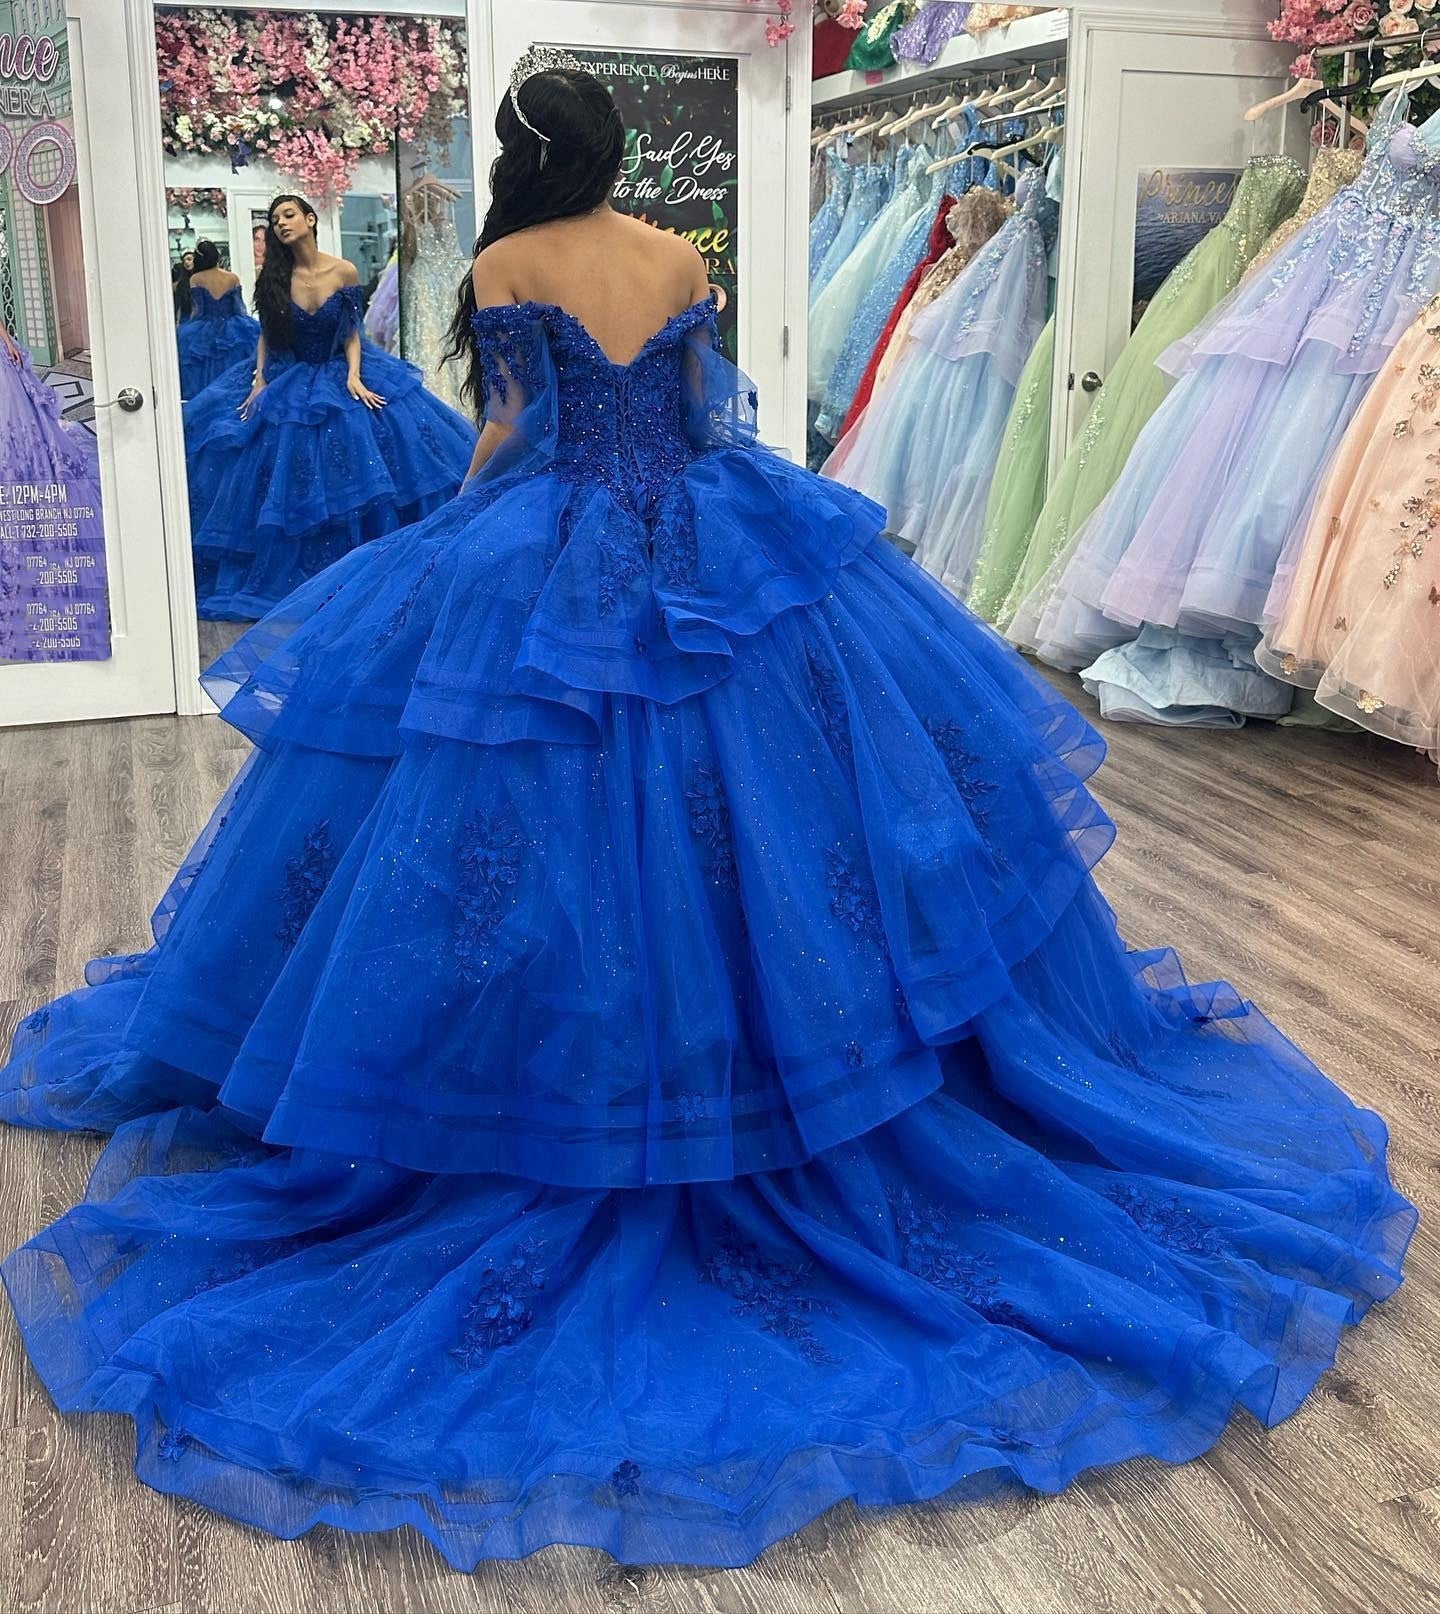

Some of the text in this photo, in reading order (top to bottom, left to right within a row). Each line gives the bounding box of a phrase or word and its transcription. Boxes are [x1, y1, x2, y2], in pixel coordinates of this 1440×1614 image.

[661, 64, 698, 84] Begins
[698, 68, 730, 81] HERE
[620, 131, 736, 176] Said Yes
[612, 176, 729, 205] to the Dress
[12, 484, 67, 505] 12PM-4PM
[17, 508, 34, 521] LONG
[36, 507, 62, 521] BRANCH
[63, 508, 73, 519] NJ
[73, 506, 95, 519] 07764
[22, 523, 78, 539] 732-200-5505
[74, 555, 95, 568] 07764
[74, 602, 95, 615] 07764
